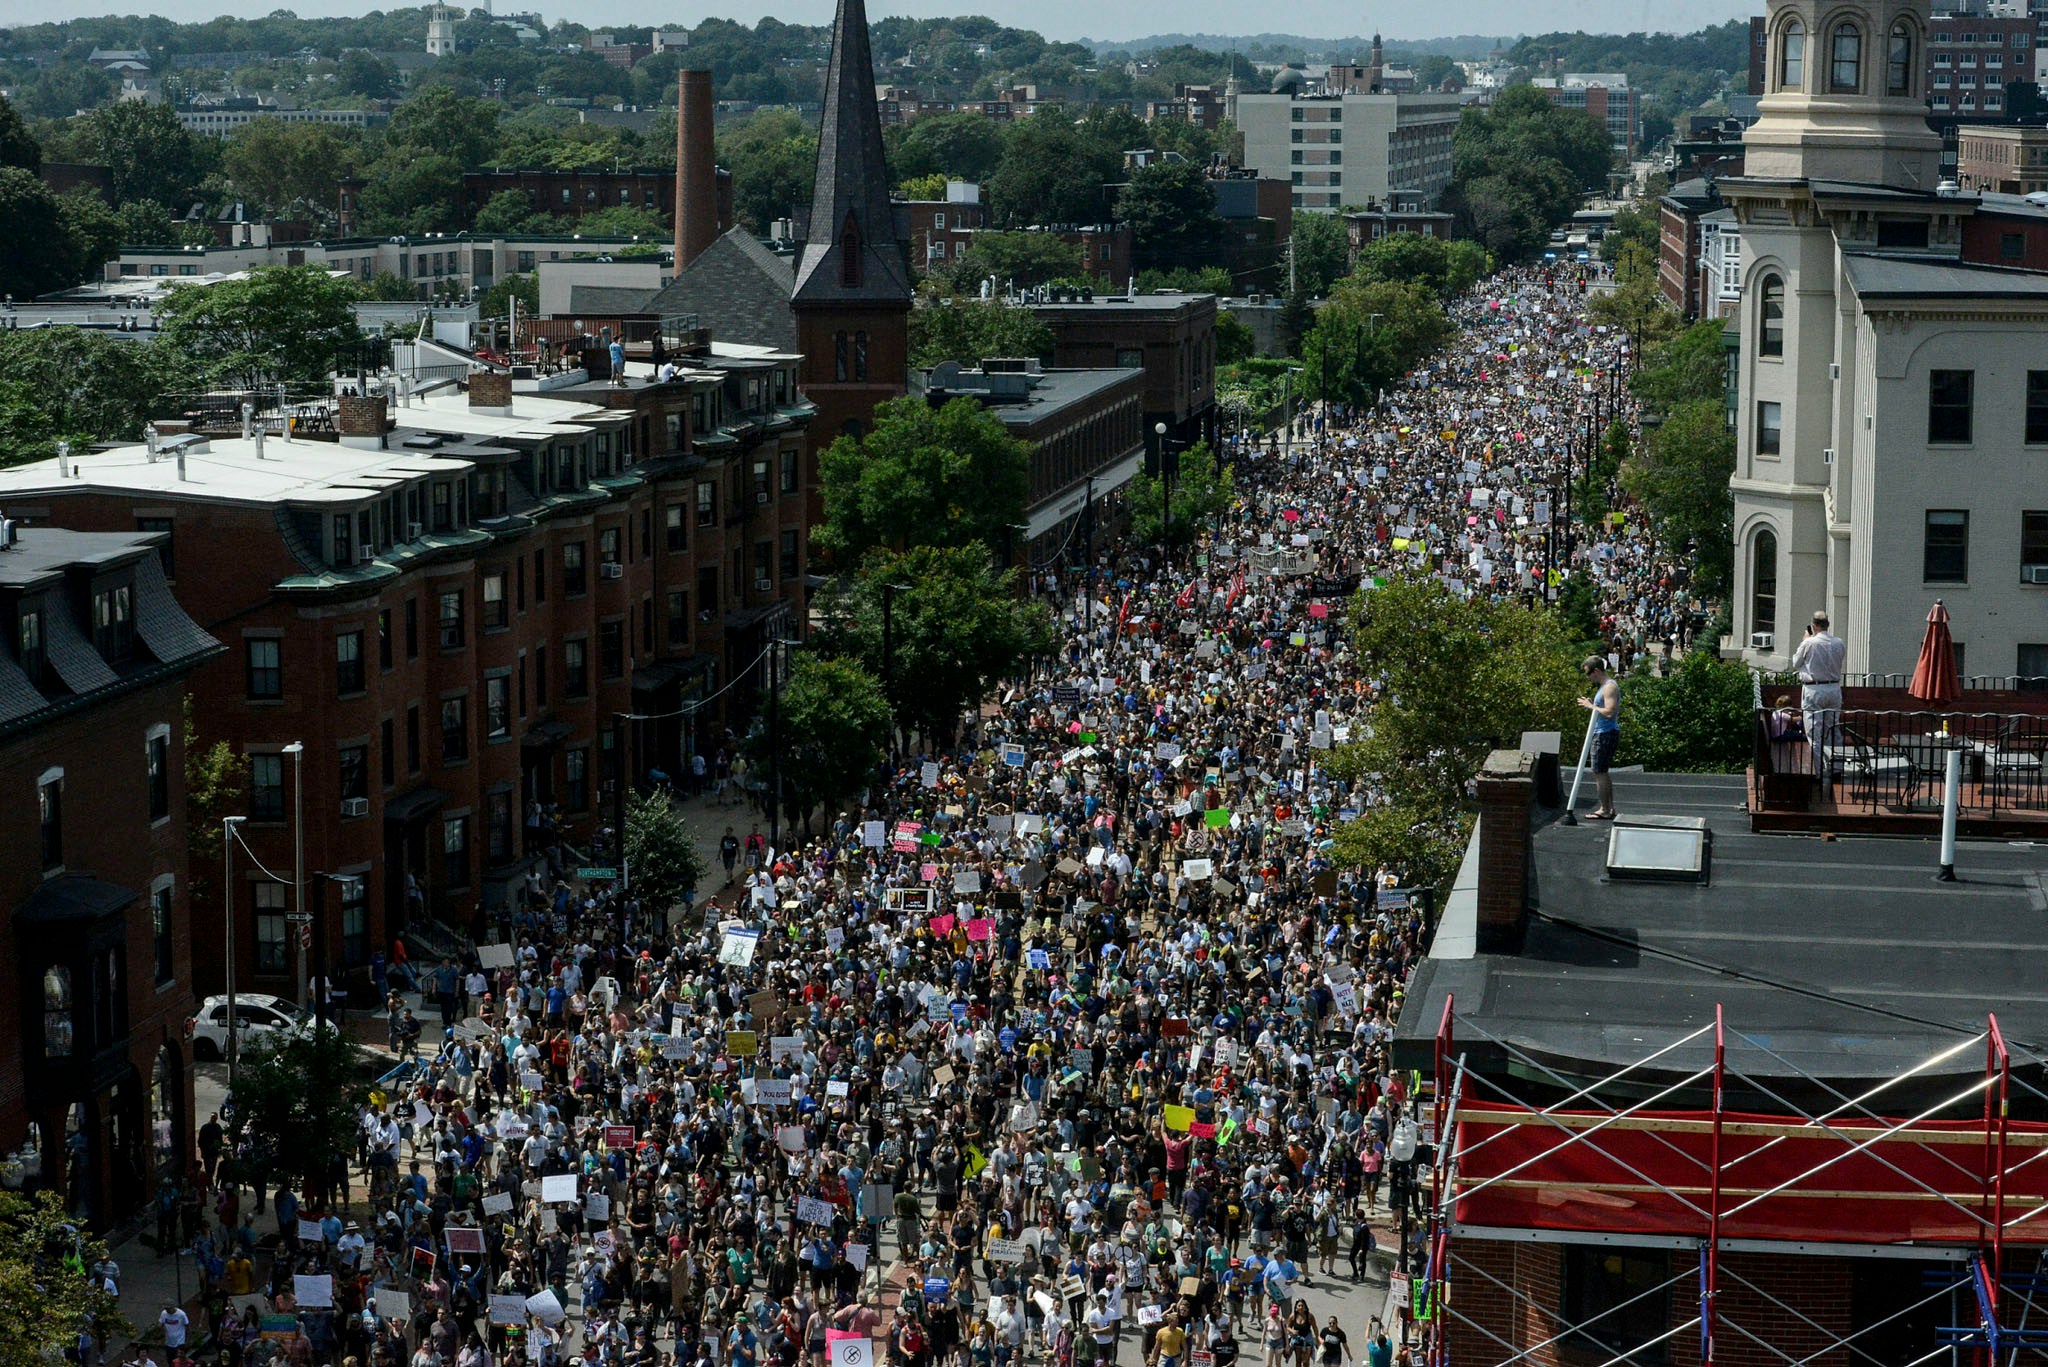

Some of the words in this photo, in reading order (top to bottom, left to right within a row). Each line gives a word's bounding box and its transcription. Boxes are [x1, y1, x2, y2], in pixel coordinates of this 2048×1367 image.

[898, 821, 922, 829] CLOSED
[662, 1037, 676, 1047] END
[641, 1145, 655, 1158] NO
[800, 1210, 829, 1225] AMERICA
[1141, 1310, 1158, 1321] LOVE
